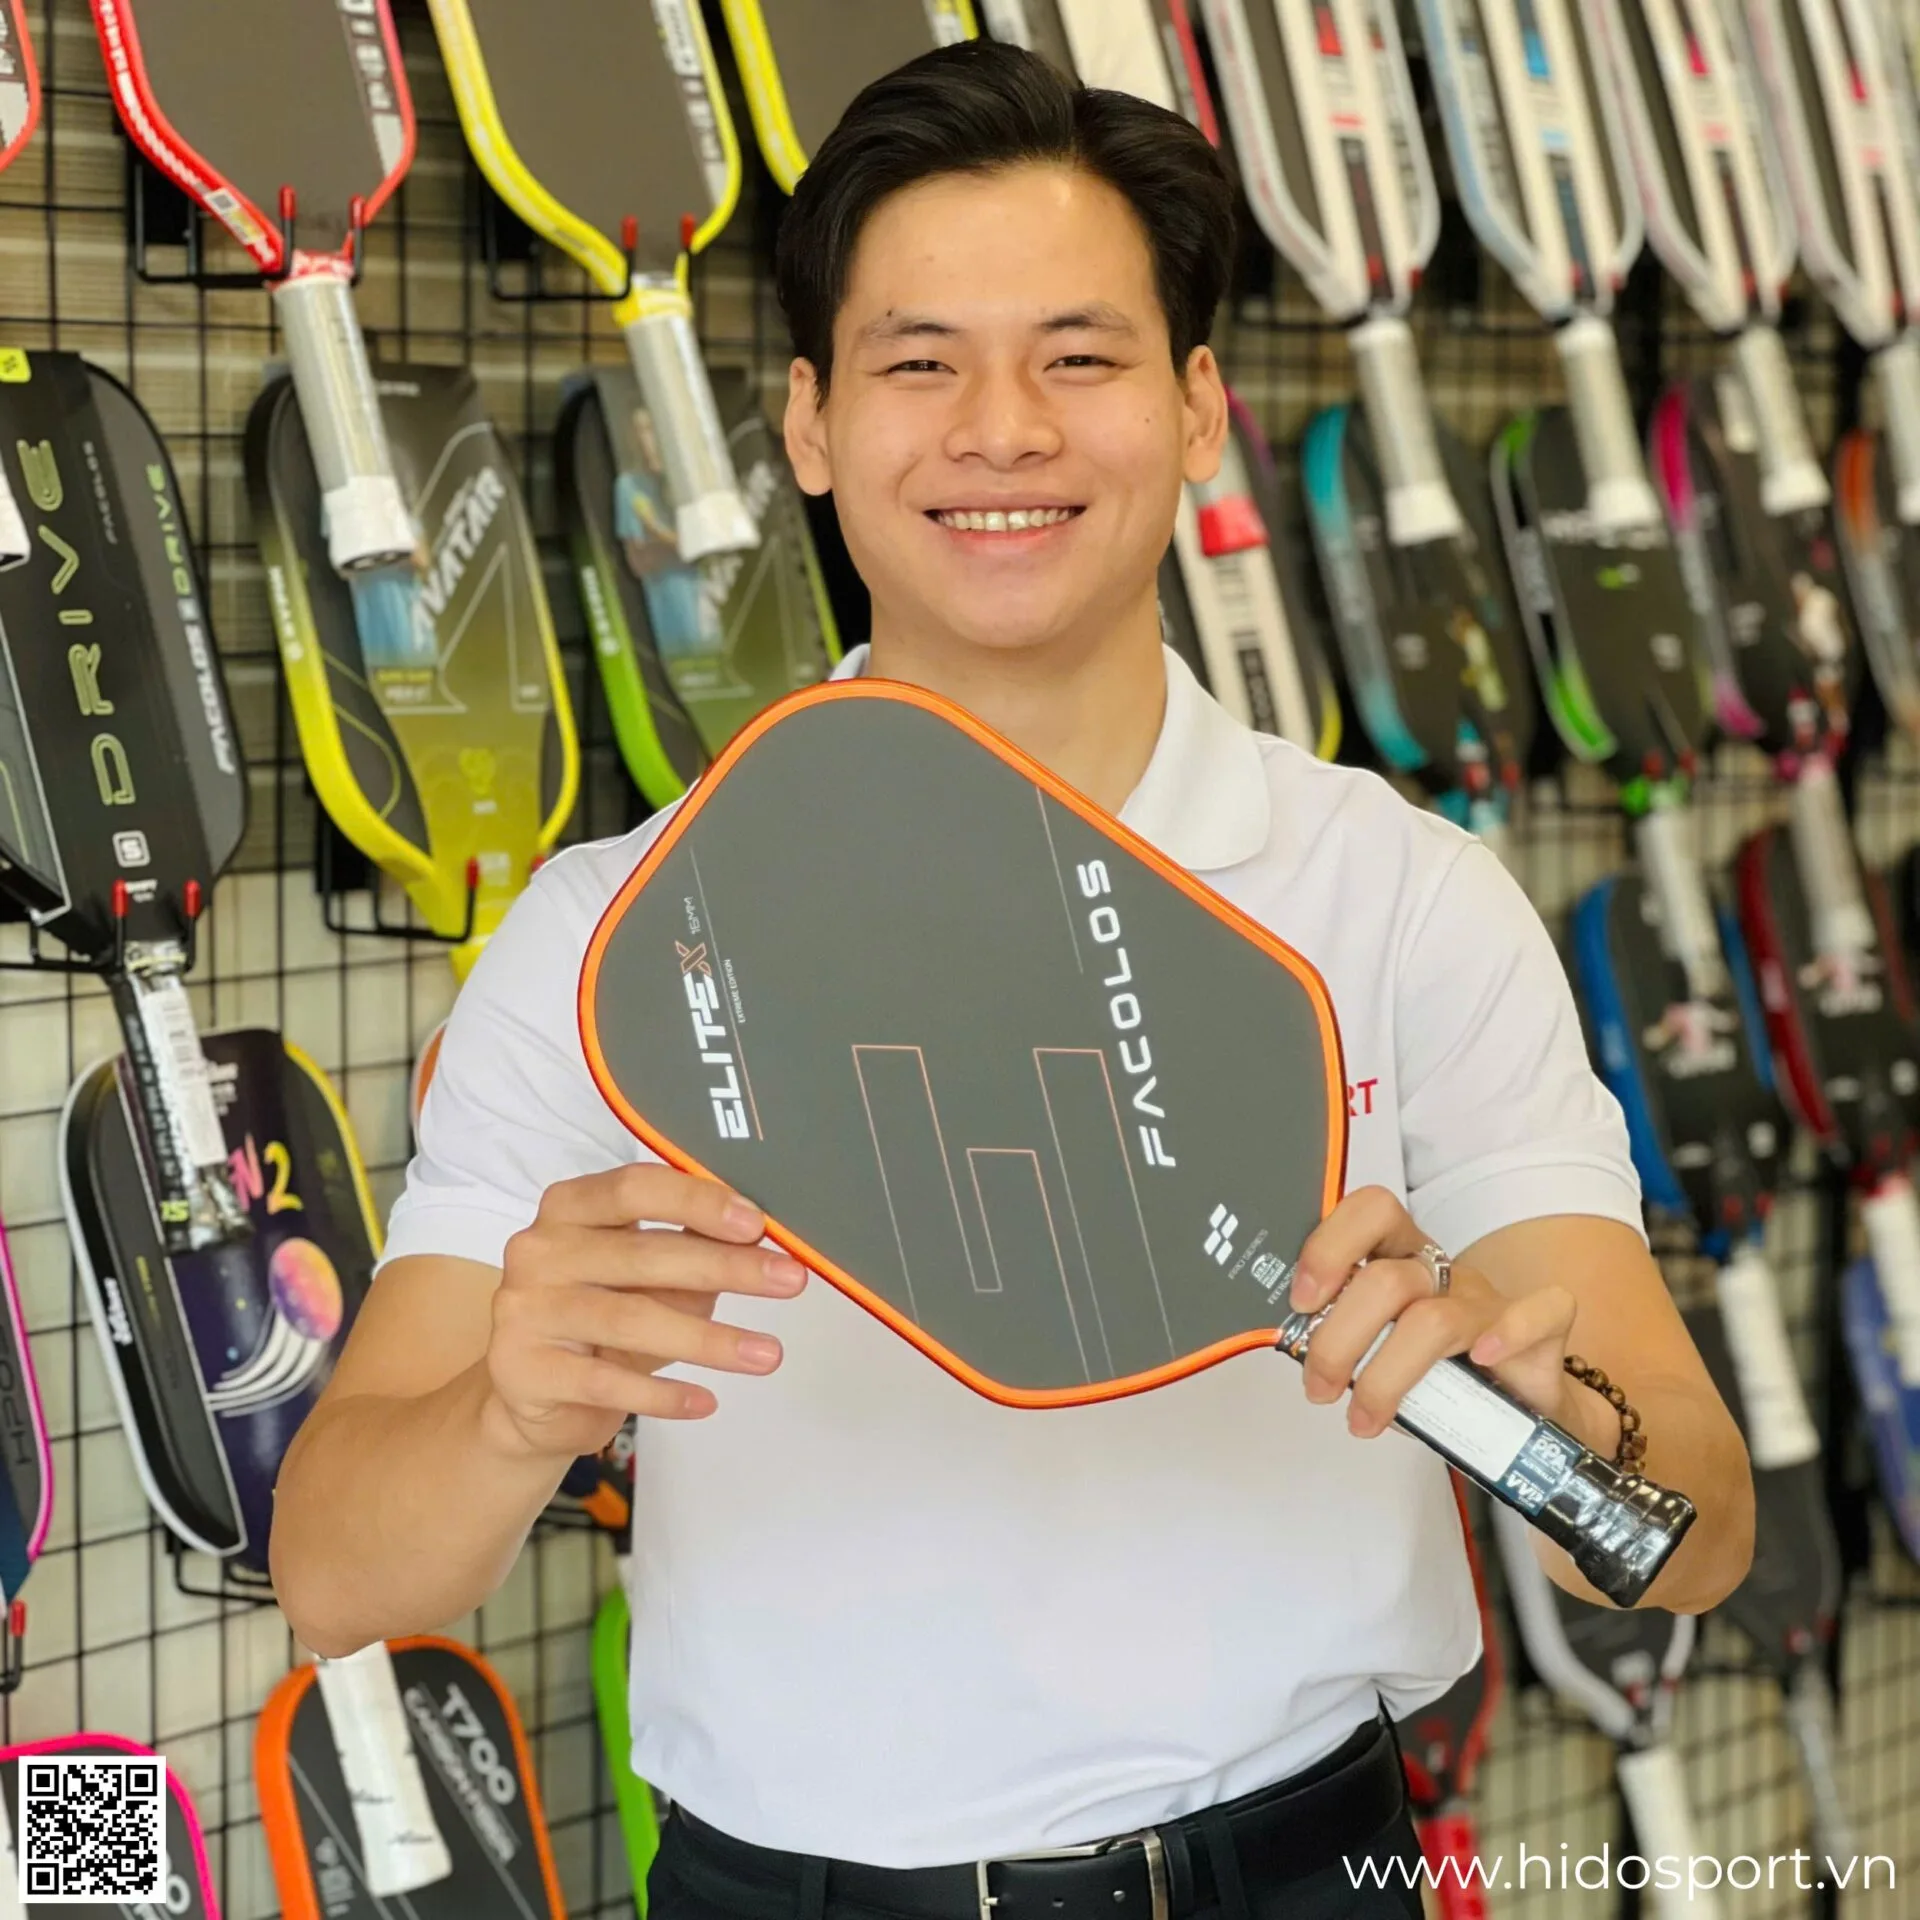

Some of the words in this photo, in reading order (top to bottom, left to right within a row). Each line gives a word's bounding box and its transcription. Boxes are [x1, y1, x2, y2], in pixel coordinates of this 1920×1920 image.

[146, 463, 191, 597] DRIVE
[411, 466, 505, 652] AVATAR
[17, 439, 136, 806] DRIVE
[185, 624, 235, 775] FACOLOS
[683, 896, 701, 935] 16MM
[723, 958, 739, 987] EDITION
[732, 988, 746, 1024] EXTREME
[1077, 859, 1176, 1168] FACOLOS
[441, 1682, 516, 1806] T700
